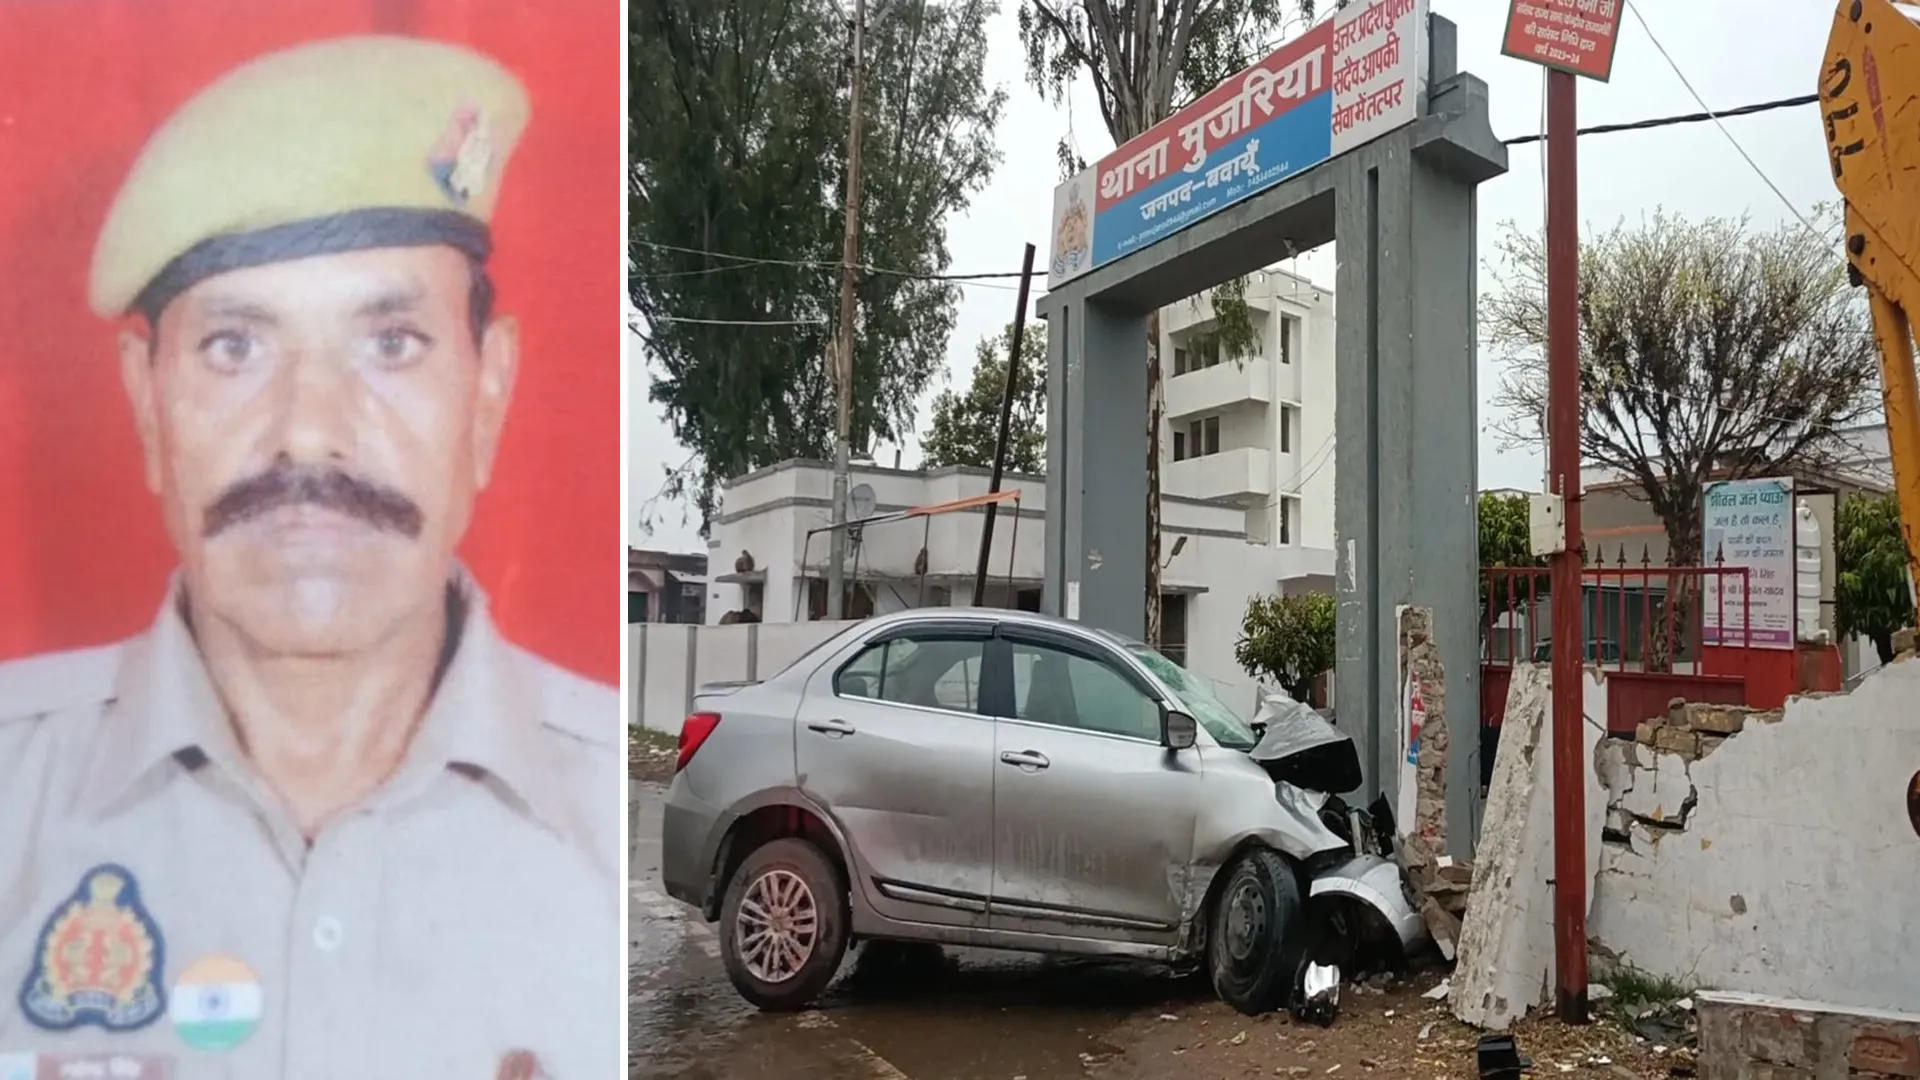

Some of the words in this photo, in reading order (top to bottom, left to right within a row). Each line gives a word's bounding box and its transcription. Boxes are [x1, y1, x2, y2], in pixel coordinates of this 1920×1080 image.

[1333, 18, 1356, 56] उत्तर
[1358, 2, 1384, 41] प्रदेश
[1100, 137, 1170, 200] थाना
[1178, 45, 1327, 172] मुजरिया
[1332, 104, 1355, 136] सेवा
[1355, 92, 1367, 121] में
[1367, 79, 1404, 122] तत्पर
